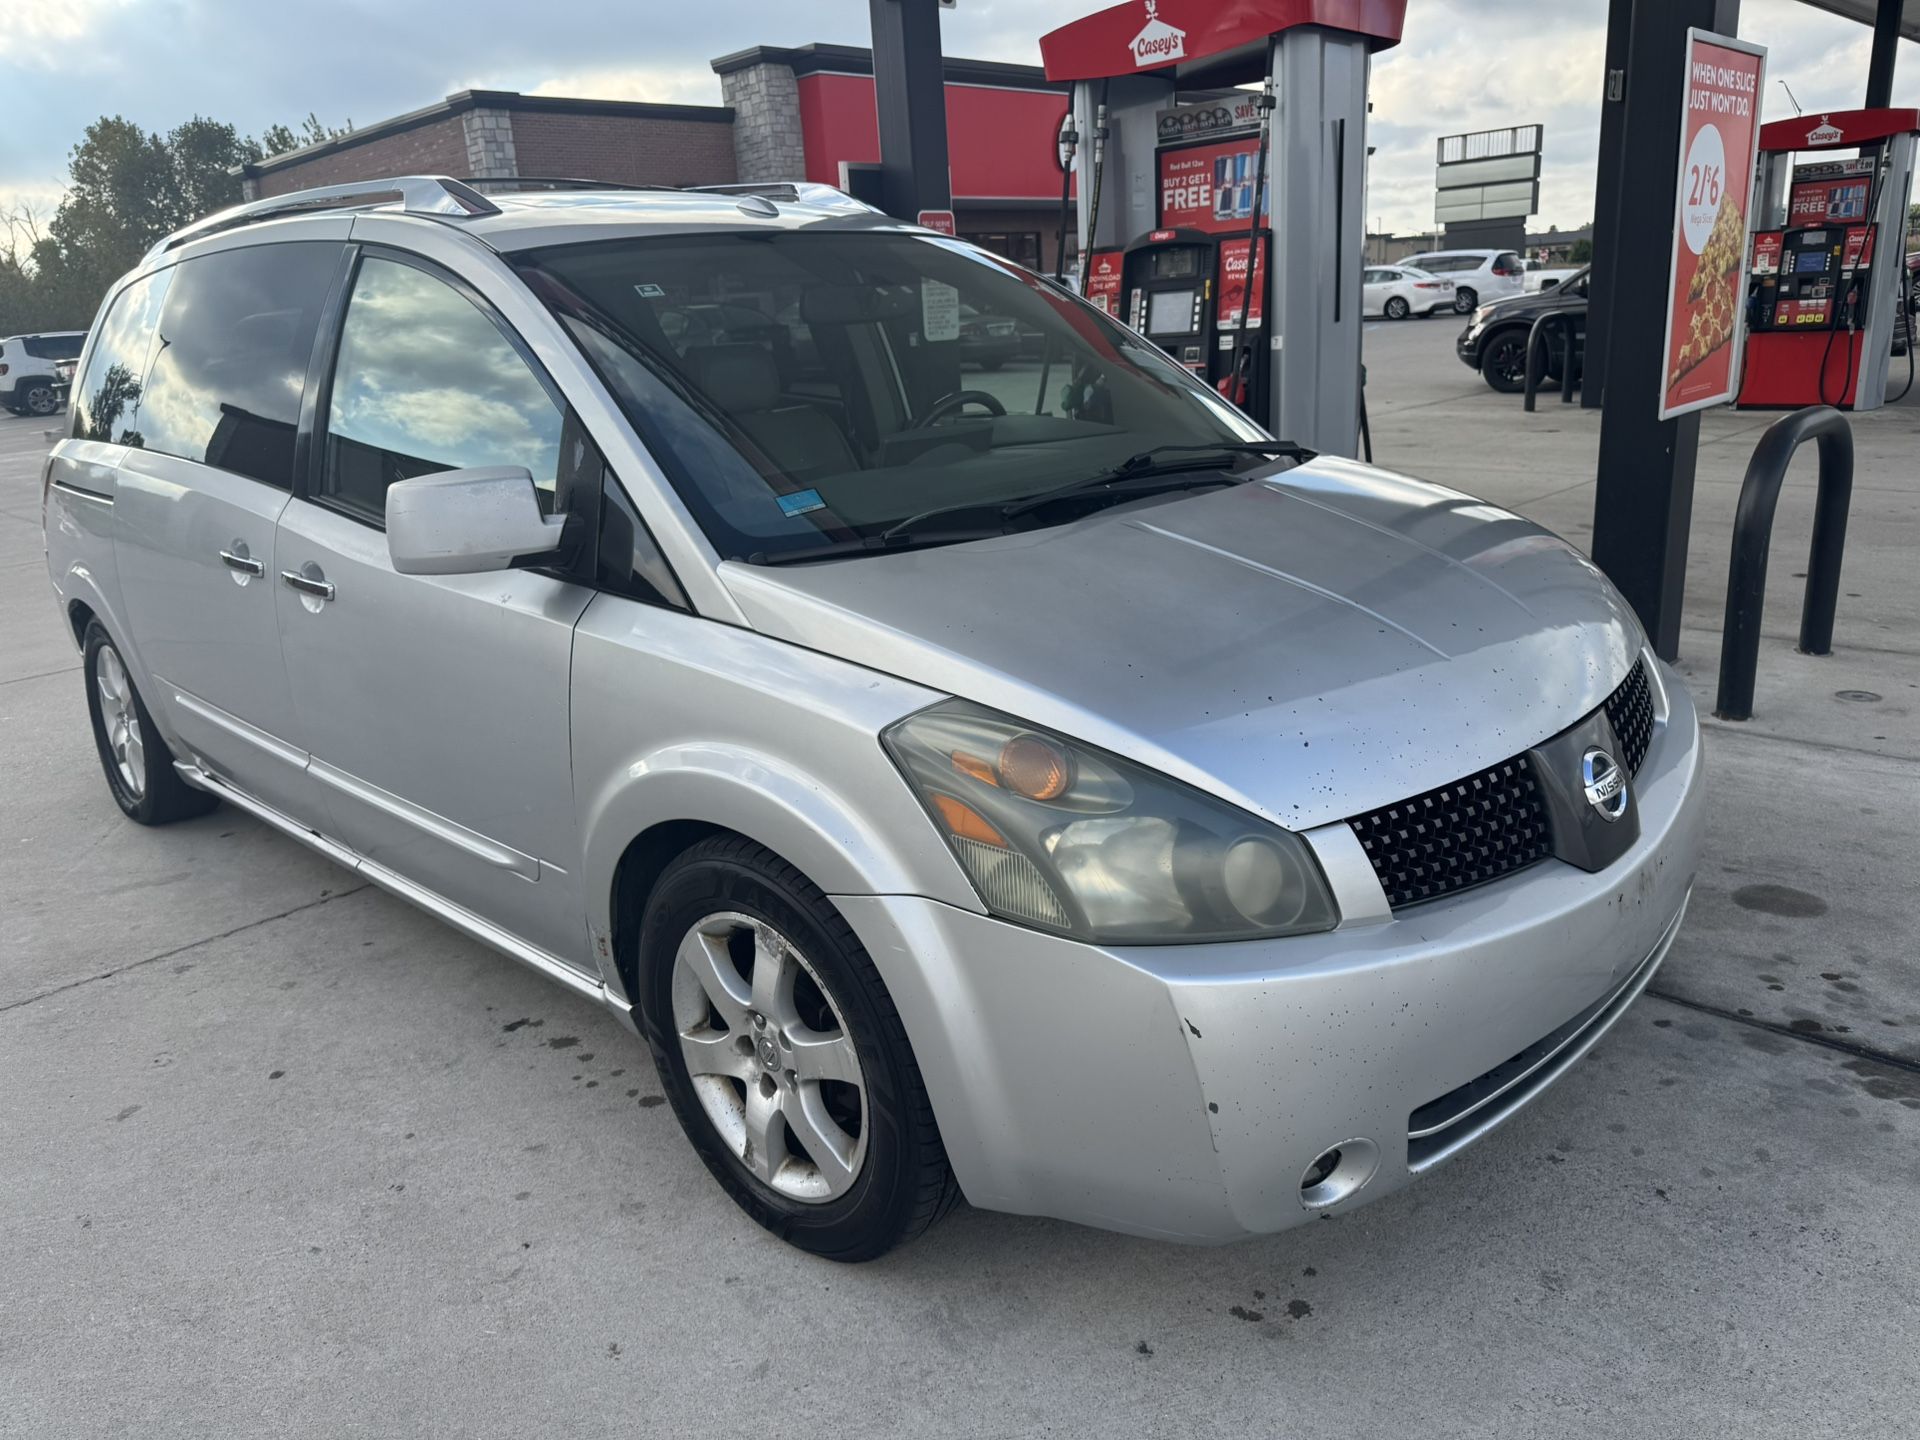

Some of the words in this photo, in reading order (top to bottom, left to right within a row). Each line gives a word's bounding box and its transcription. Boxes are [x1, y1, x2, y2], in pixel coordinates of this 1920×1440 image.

[1137, 32, 1179, 58] Casey's
[1692, 61, 1717, 86] WHEN
[1718, 67, 1735, 89] ONE
[1736, 71, 1756, 93] SLICE
[1234, 103, 1255, 120] SAVE
[1689, 89, 1710, 111] JUST
[1711, 92, 1736, 115] WON'T
[1736, 96, 1750, 117] DO.
[1810, 130, 1840, 141] Casey's
[1163, 177, 1180, 189] BUY
[1181, 176, 1187, 186] 2
[1188, 173, 1205, 185] GET
[1207, 172, 1211, 183] 1
[1163, 184, 1211, 211] FREE
[1792, 201, 1826, 214] FREE
[1226, 257, 1259, 272] Cases
[1089, 274, 1120, 283] DOWNLOAD
[1595, 774, 1624, 799] NISS
